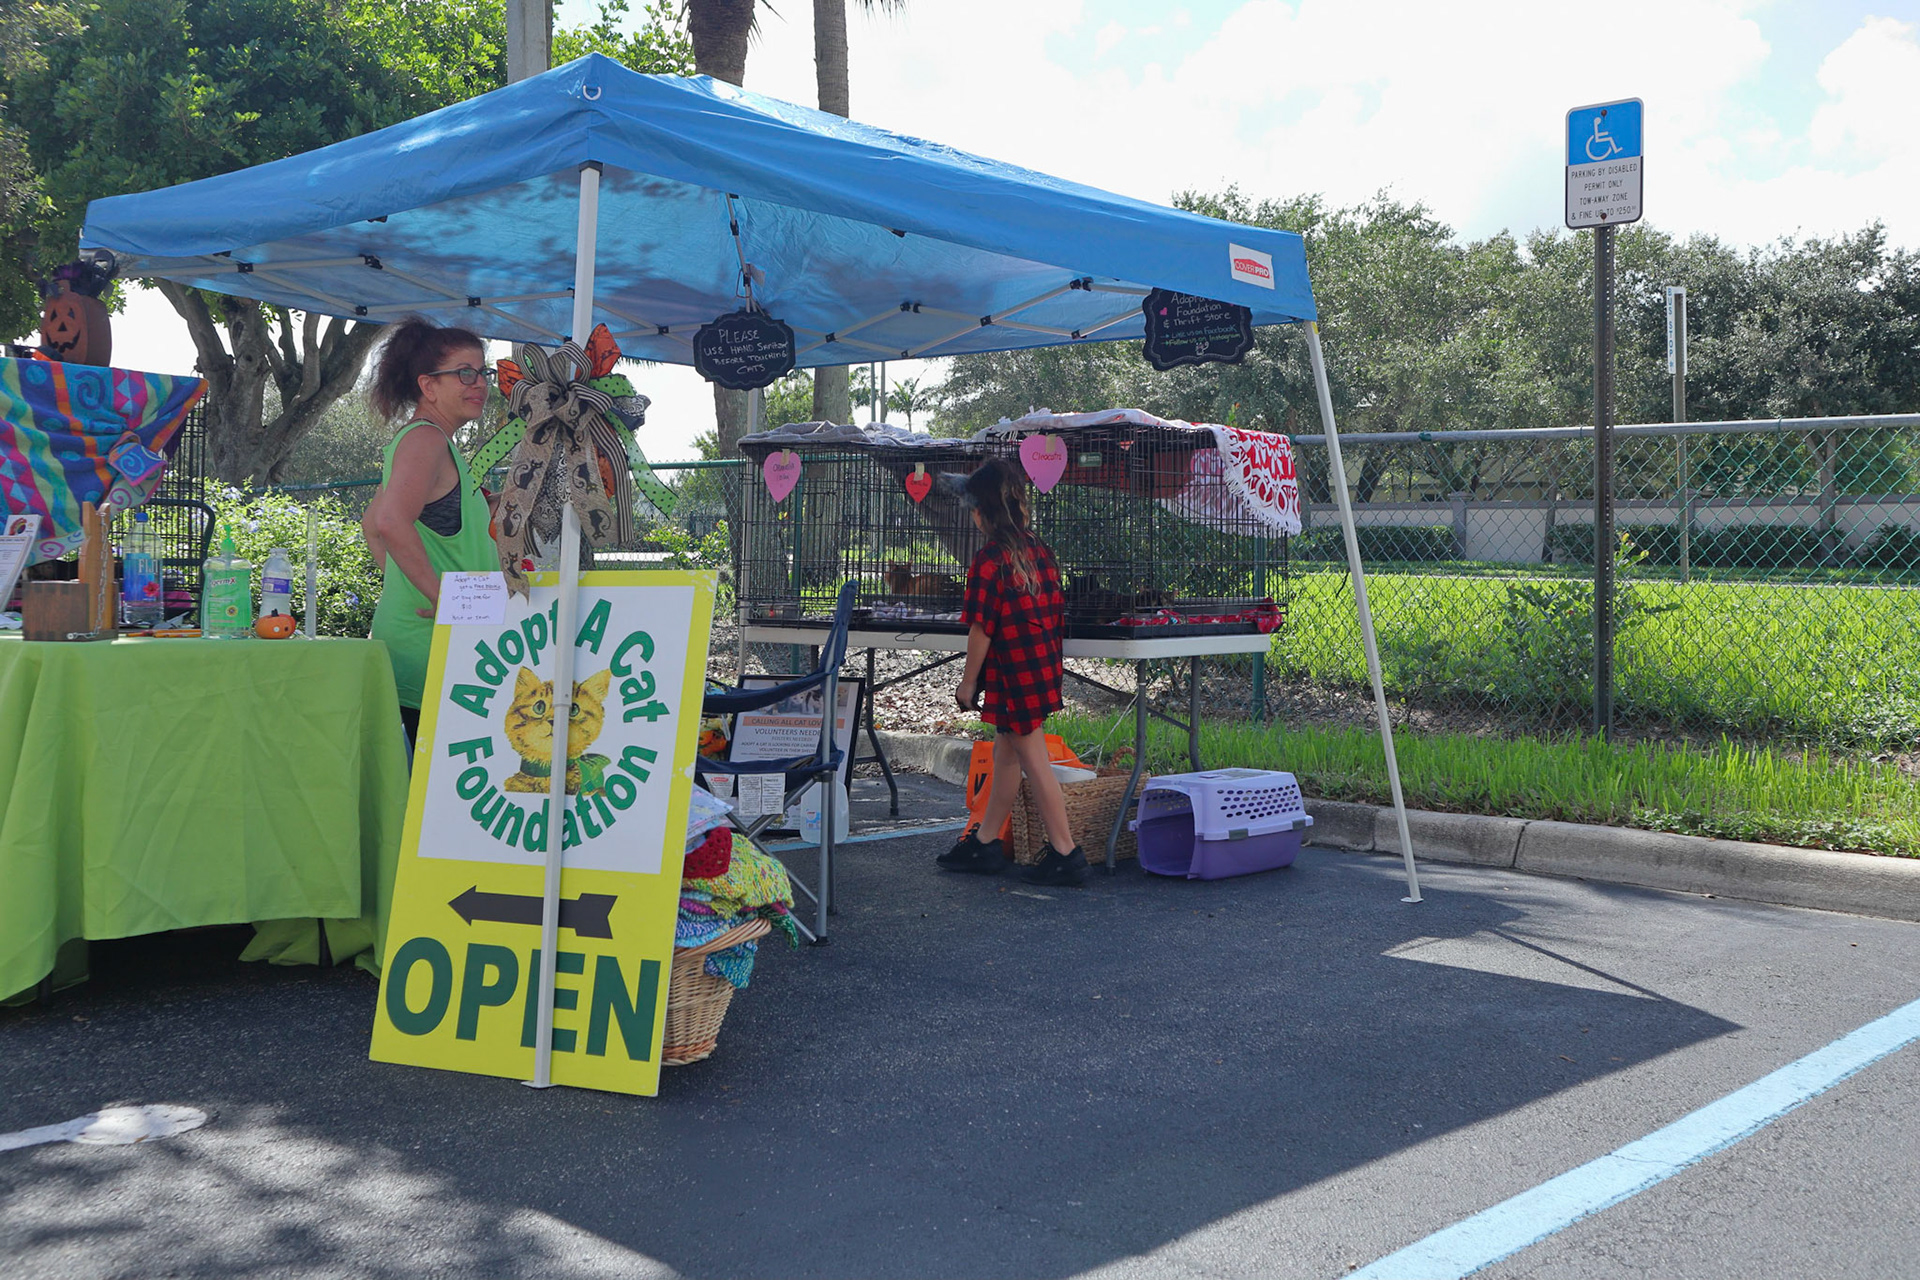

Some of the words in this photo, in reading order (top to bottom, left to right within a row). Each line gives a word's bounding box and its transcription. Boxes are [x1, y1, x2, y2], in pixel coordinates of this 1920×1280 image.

[1572, 169, 1596, 178] PARKING
[1598, 168, 1605, 176] BY
[1608, 163, 1637, 174] DISABLED
[1584, 181, 1605, 191] PERMIT
[1608, 180, 1623, 188] ONLY
[1580, 195, 1609, 205] TOW-AWAY
[1612, 192, 1628, 201] ZONE
[1579, 210, 1593, 219] FINE
[1606, 207, 1614, 216] TO
[1176, 303, 1222, 317] Foundation
[1174, 315, 1201, 326] Thrift
[719, 329, 760, 344] PLEASE
[704, 347, 724, 356] USE
[730, 344, 755, 355] HAND
[713, 357, 744, 365] BEFORE
[736, 364, 766, 374] CATS
[139, 558, 158, 574] FIJI
[575, 598, 612, 655] A
[609, 630, 671, 724] Cat
[386, 937, 661, 1062] OPEN
